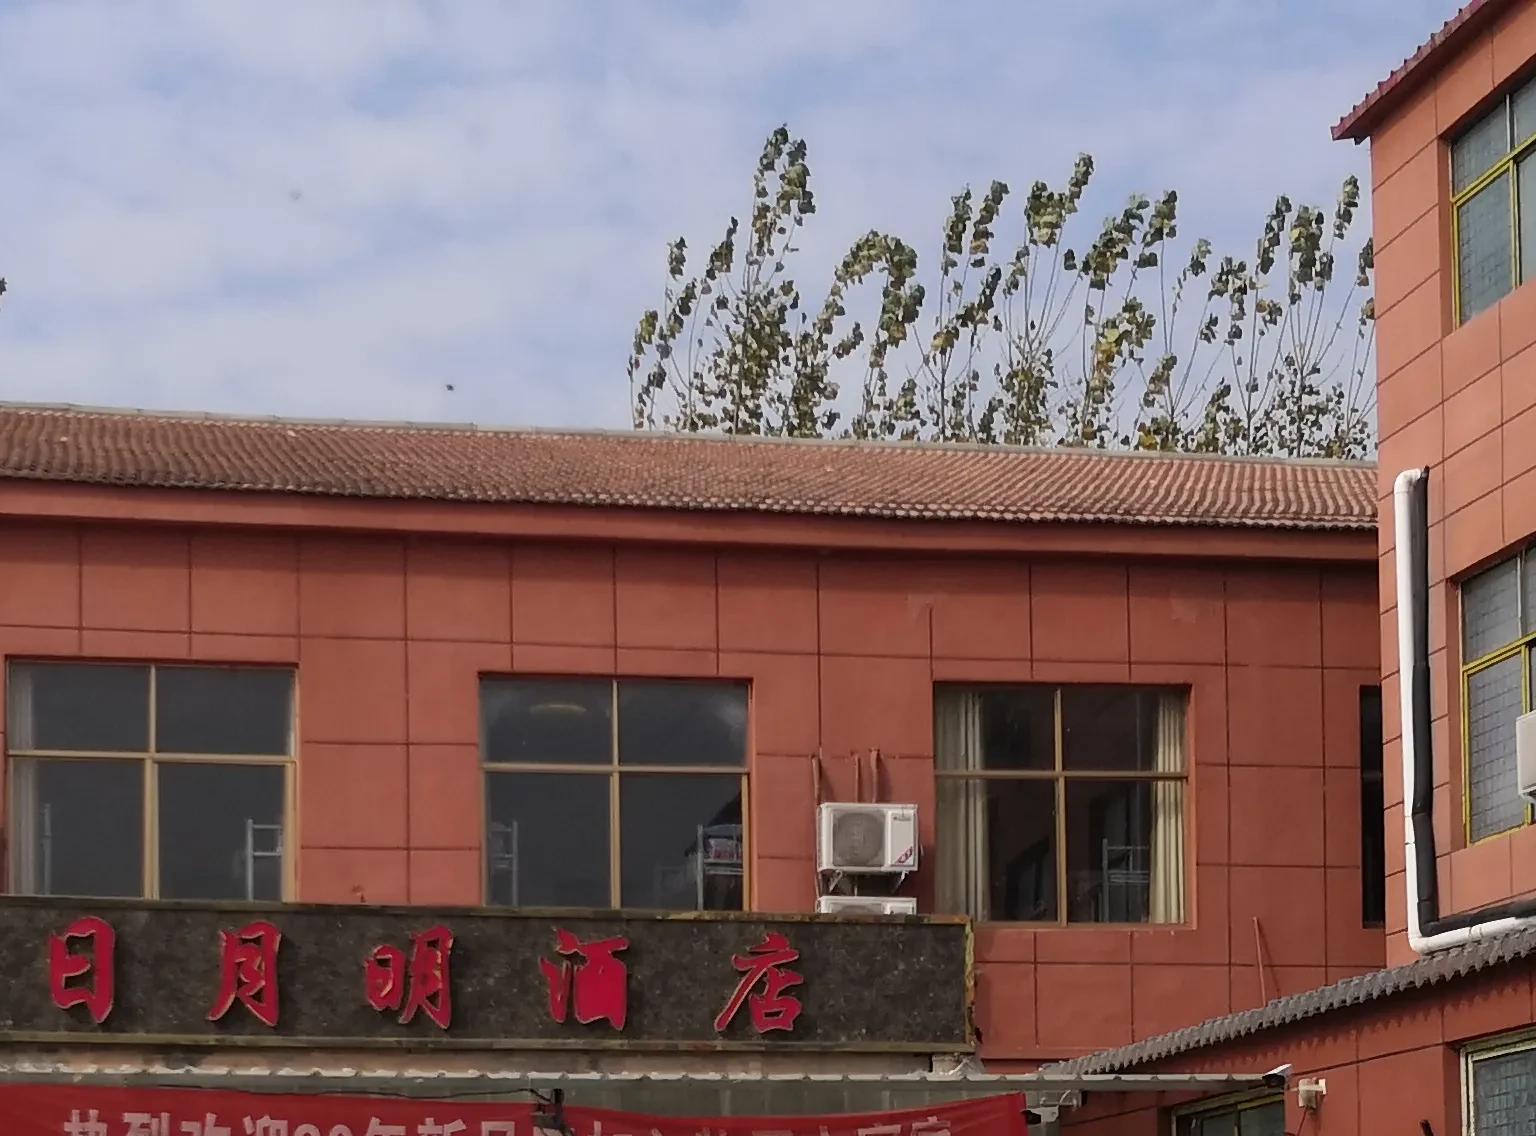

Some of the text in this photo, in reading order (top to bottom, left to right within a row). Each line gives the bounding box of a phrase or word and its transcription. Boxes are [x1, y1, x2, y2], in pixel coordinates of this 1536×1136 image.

[47, 915, 805, 1033] 日月明酒店
